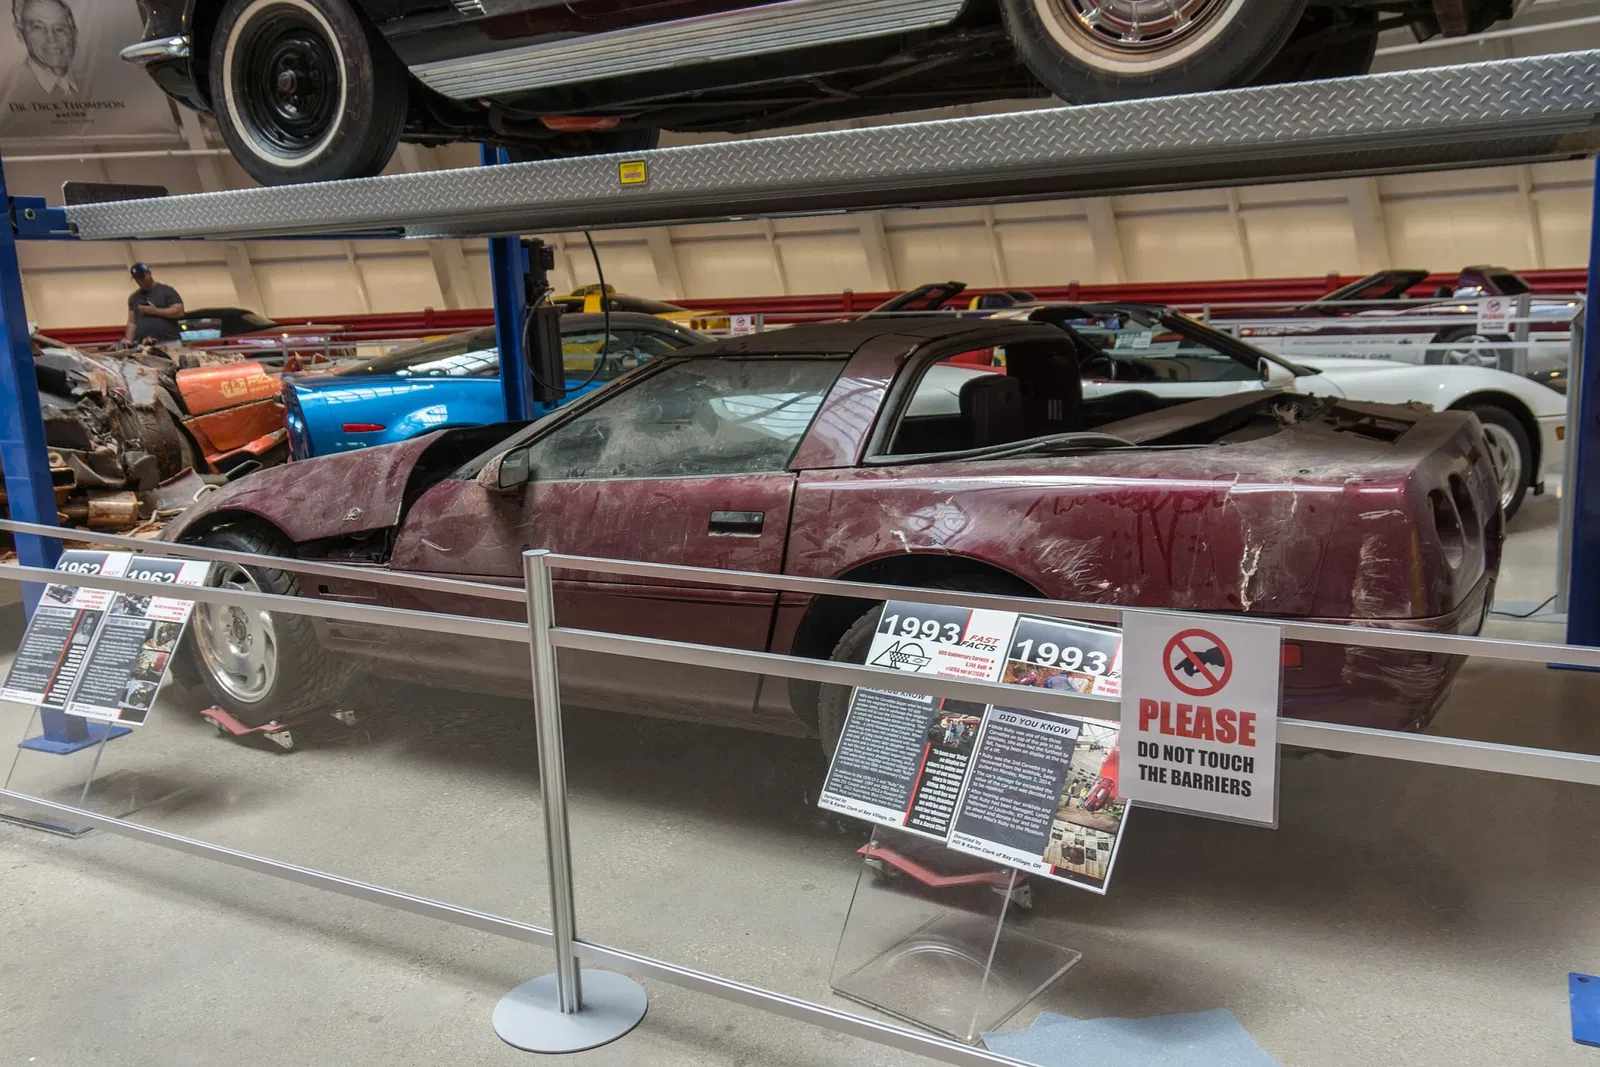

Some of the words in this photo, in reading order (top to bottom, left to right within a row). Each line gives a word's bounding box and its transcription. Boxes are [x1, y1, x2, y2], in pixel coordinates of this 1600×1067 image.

[63, 100, 125, 110] THOMPSON
[884, 614, 960, 645] 1993
[960, 639, 998, 652] FACTS
[969, 633, 1001, 646] FAST
[1017, 638, 1108, 676] 1993
[998, 713, 1017, 723] DID
[1018, 718, 1038, 727] YOU
[1039, 722, 1071, 735] KNOW
[1139, 698, 1256, 747] PLEASE
[988, 729, 1010, 737] Corvettes
[1020, 762, 1040, 770] Corvette
[1138, 741, 1159, 759] DO
[1163, 745, 1194, 764] NOT
[1198, 750, 1254, 774] TOUCH
[1138, 764, 1167, 784] THE
[1171, 769, 1252, 797] BARRIERS
[823, 793, 841, 801] Donated
[953, 833, 974, 842] Donated
[966, 843, 981, 851] Karen
[981, 847, 994, 855] Clark
[1001, 853, 1011, 861] Bay
[1012, 857, 1031, 867] Village,
